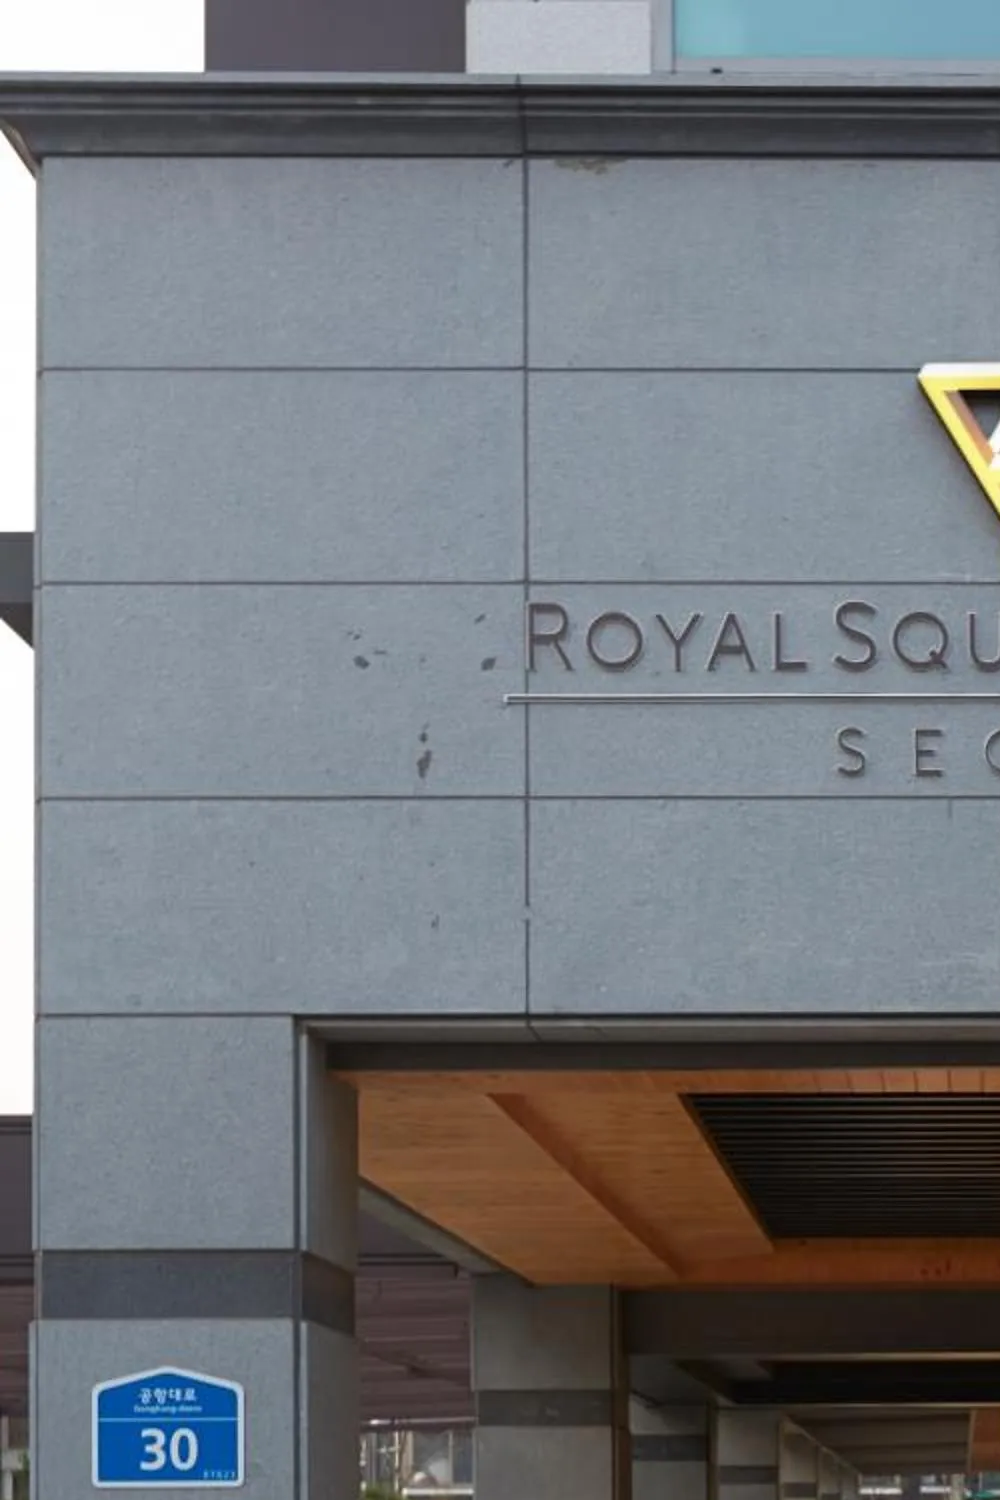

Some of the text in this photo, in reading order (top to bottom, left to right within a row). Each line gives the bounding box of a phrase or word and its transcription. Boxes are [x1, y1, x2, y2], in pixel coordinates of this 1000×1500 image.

[525, 601, 809, 674] ROYAL
[138, 1387, 198, 1405] 공항대로
[139, 1427, 199, 1472] 30
